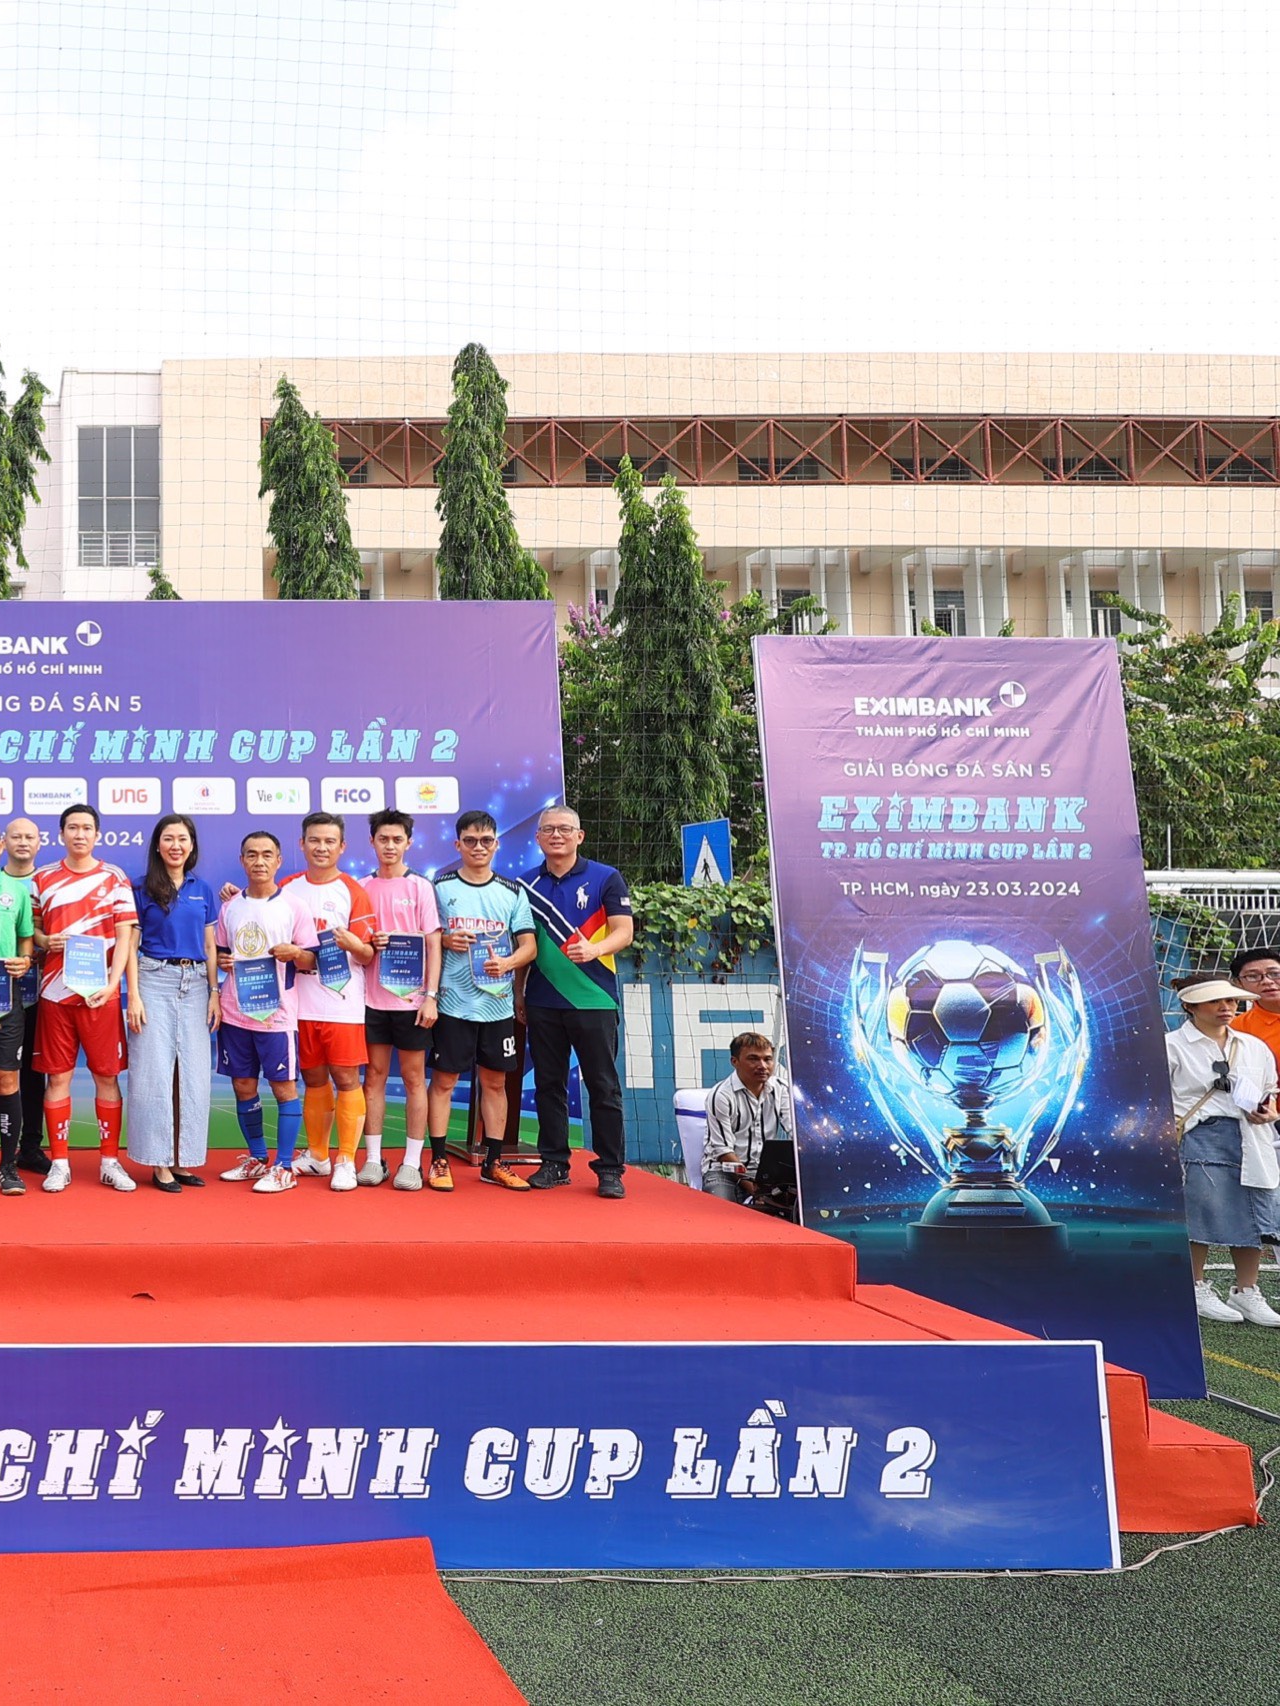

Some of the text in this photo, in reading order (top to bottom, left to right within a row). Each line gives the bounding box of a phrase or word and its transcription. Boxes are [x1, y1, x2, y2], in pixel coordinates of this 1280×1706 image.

[18, 662, 36, 674] HỒ
[41, 663, 63, 674] CHÍ
[69, 665, 102, 674] MINH
[30, 692, 63, 711] ĐÁ
[73, 692, 119, 711] SÂN
[130, 696, 141, 711] 5
[854, 697, 993, 716] EXIMBANK
[855, 723, 1029, 737] THÀNH PHỐ HỒ CHÍ MINH
[230, 730, 316, 763] CUP
[327, 718, 421, 762] LẦN
[431, 729, 458, 762] 2
[844, 757, 1051, 777] GIẢI BÓNG ĐÁ SÂN 5
[335, 788, 371, 802] FiCO
[821, 842, 849, 859] TP.
[854, 837, 882, 859] HỒ
[989, 843, 1028, 859] CUP
[1032, 837, 1075, 859] LẦN
[1079, 843, 1092, 859] 2
[840, 882, 1080, 898] TP. HCM, ngày 23.03.2024
[464, 1428, 642, 1499] CUP
[666, 1400, 857, 1498] LẦN
[880, 1427, 936, 1498] 2
